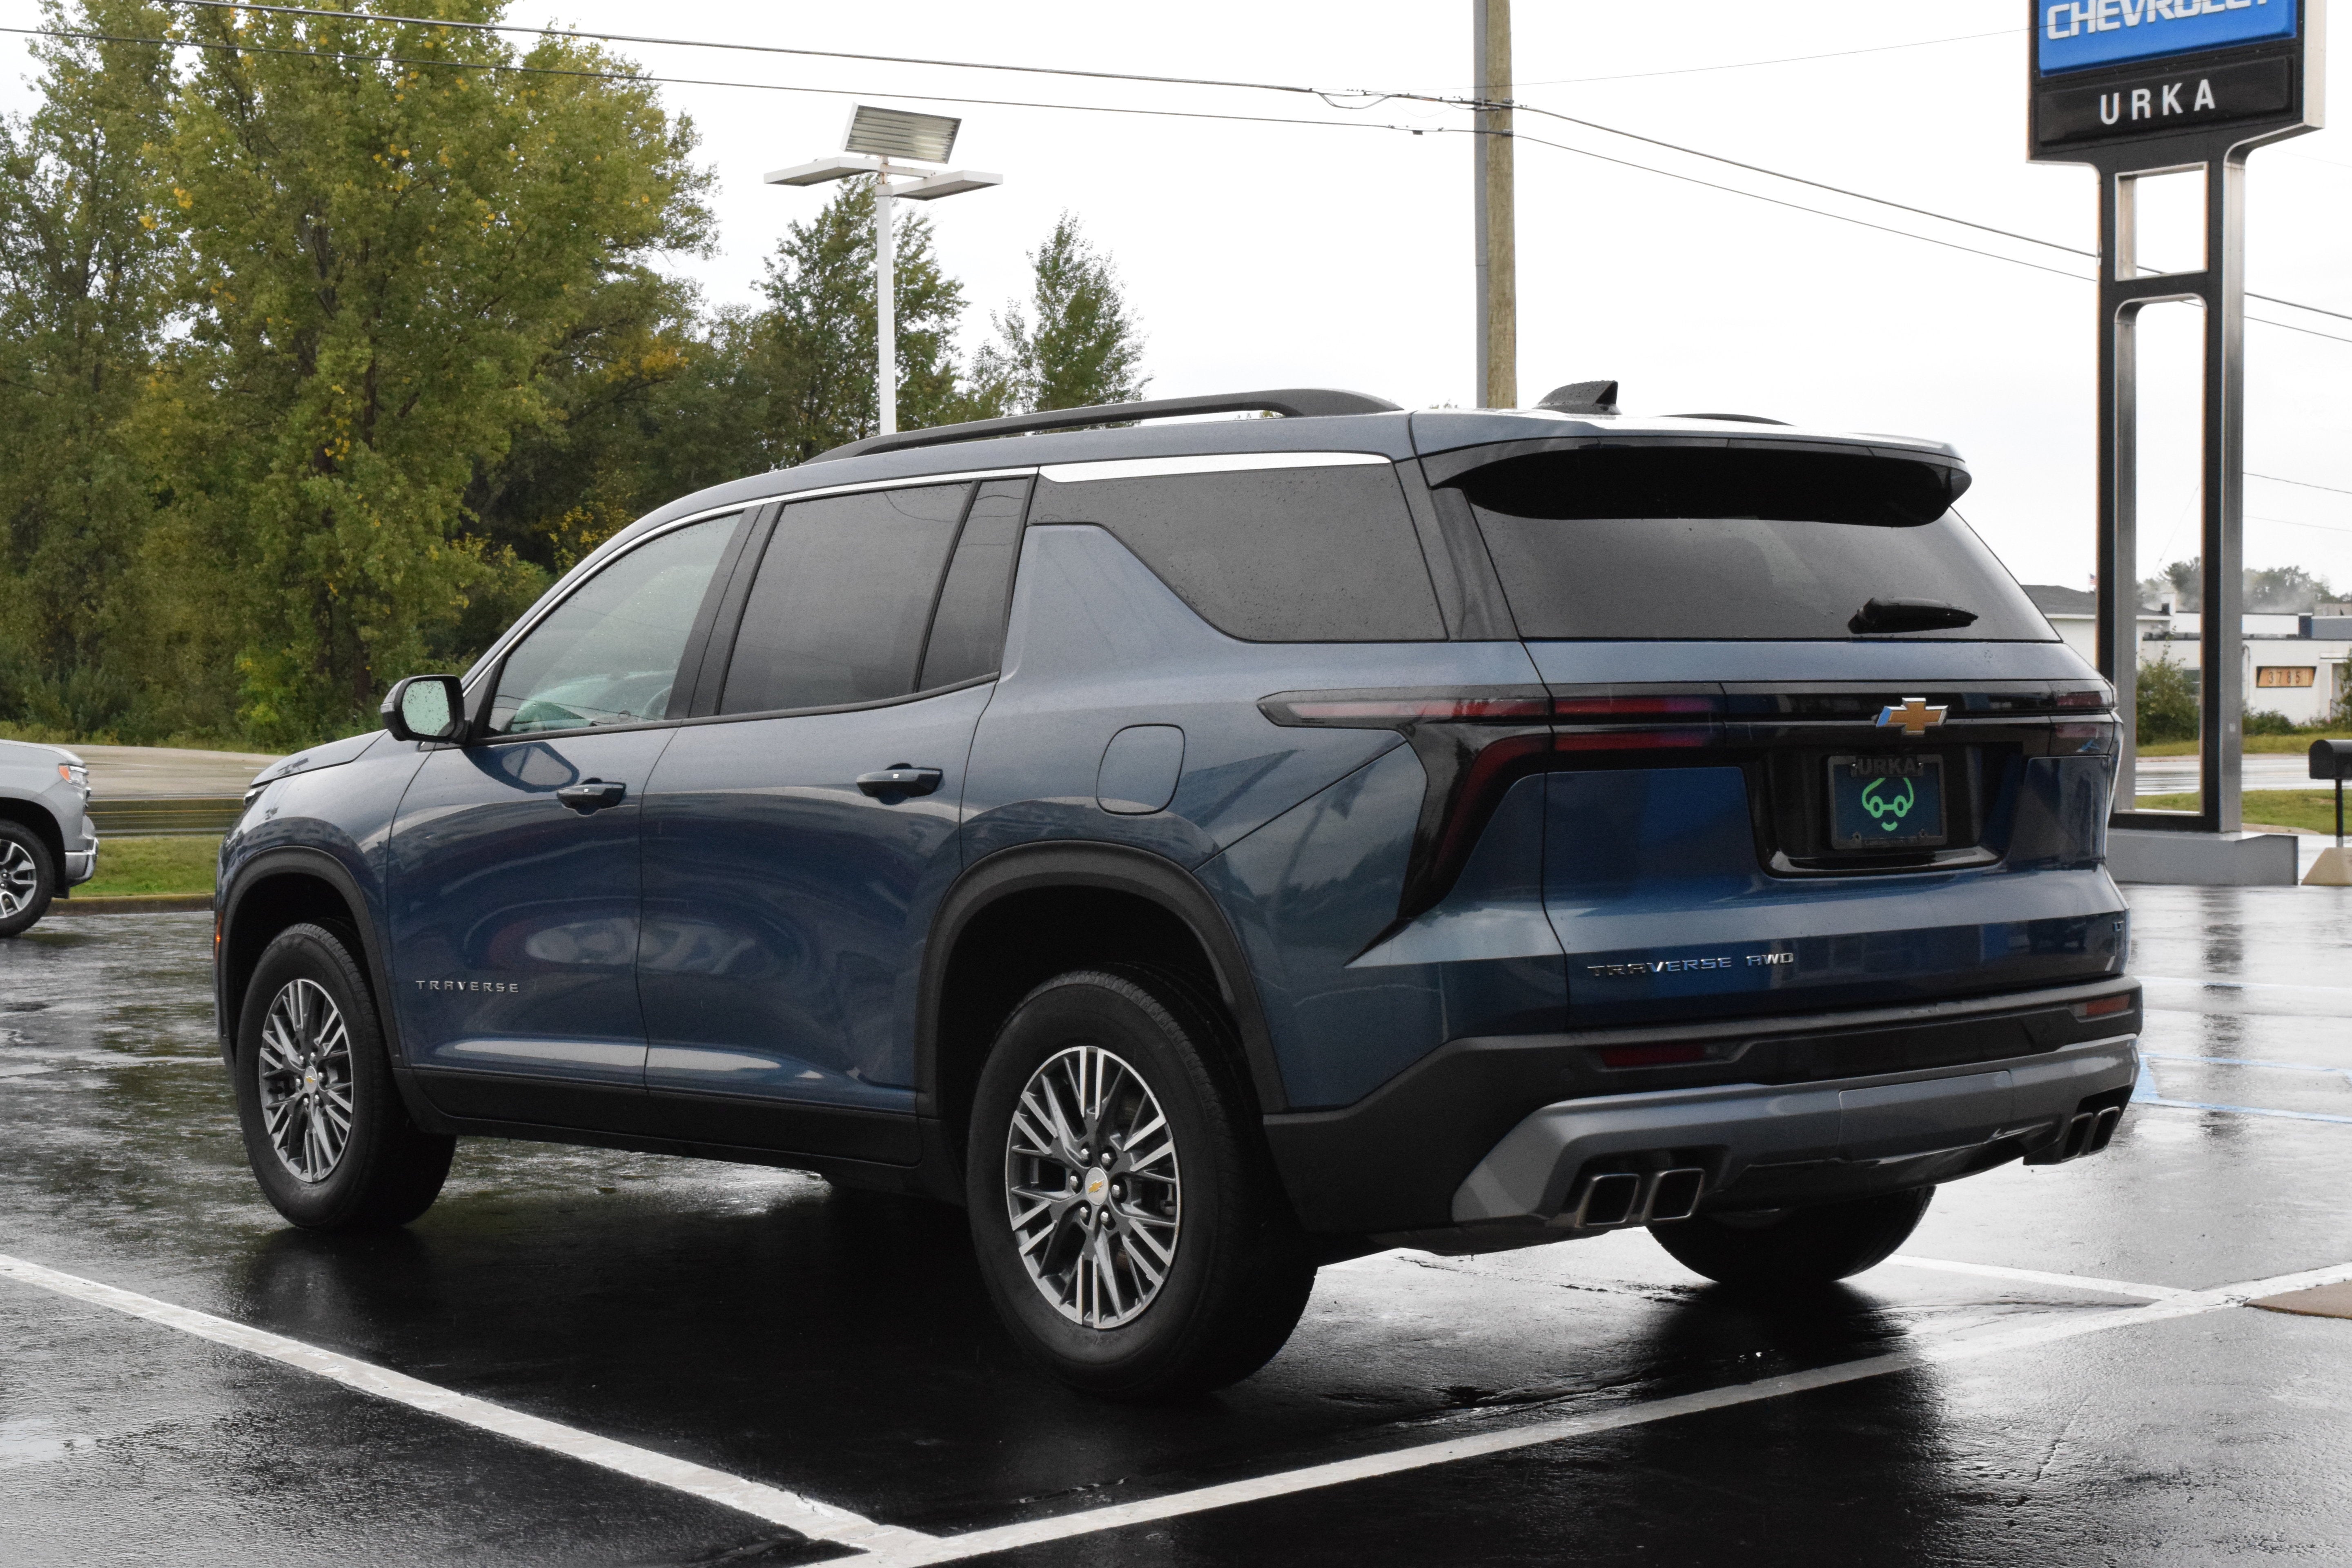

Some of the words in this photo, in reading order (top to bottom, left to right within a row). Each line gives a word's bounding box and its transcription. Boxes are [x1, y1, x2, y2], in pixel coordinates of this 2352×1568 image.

[2047, 0, 2267, 40] CHEVRO
[2100, 78, 2216, 125] URKA
[2268, 671, 2301, 684] 3785
[1858, 757, 1916, 775] URKA
[1587, 957, 1732, 976] TRAVERSE
[1746, 952, 1794, 966] AWD
[415, 980, 519, 993] TRAVERSE
